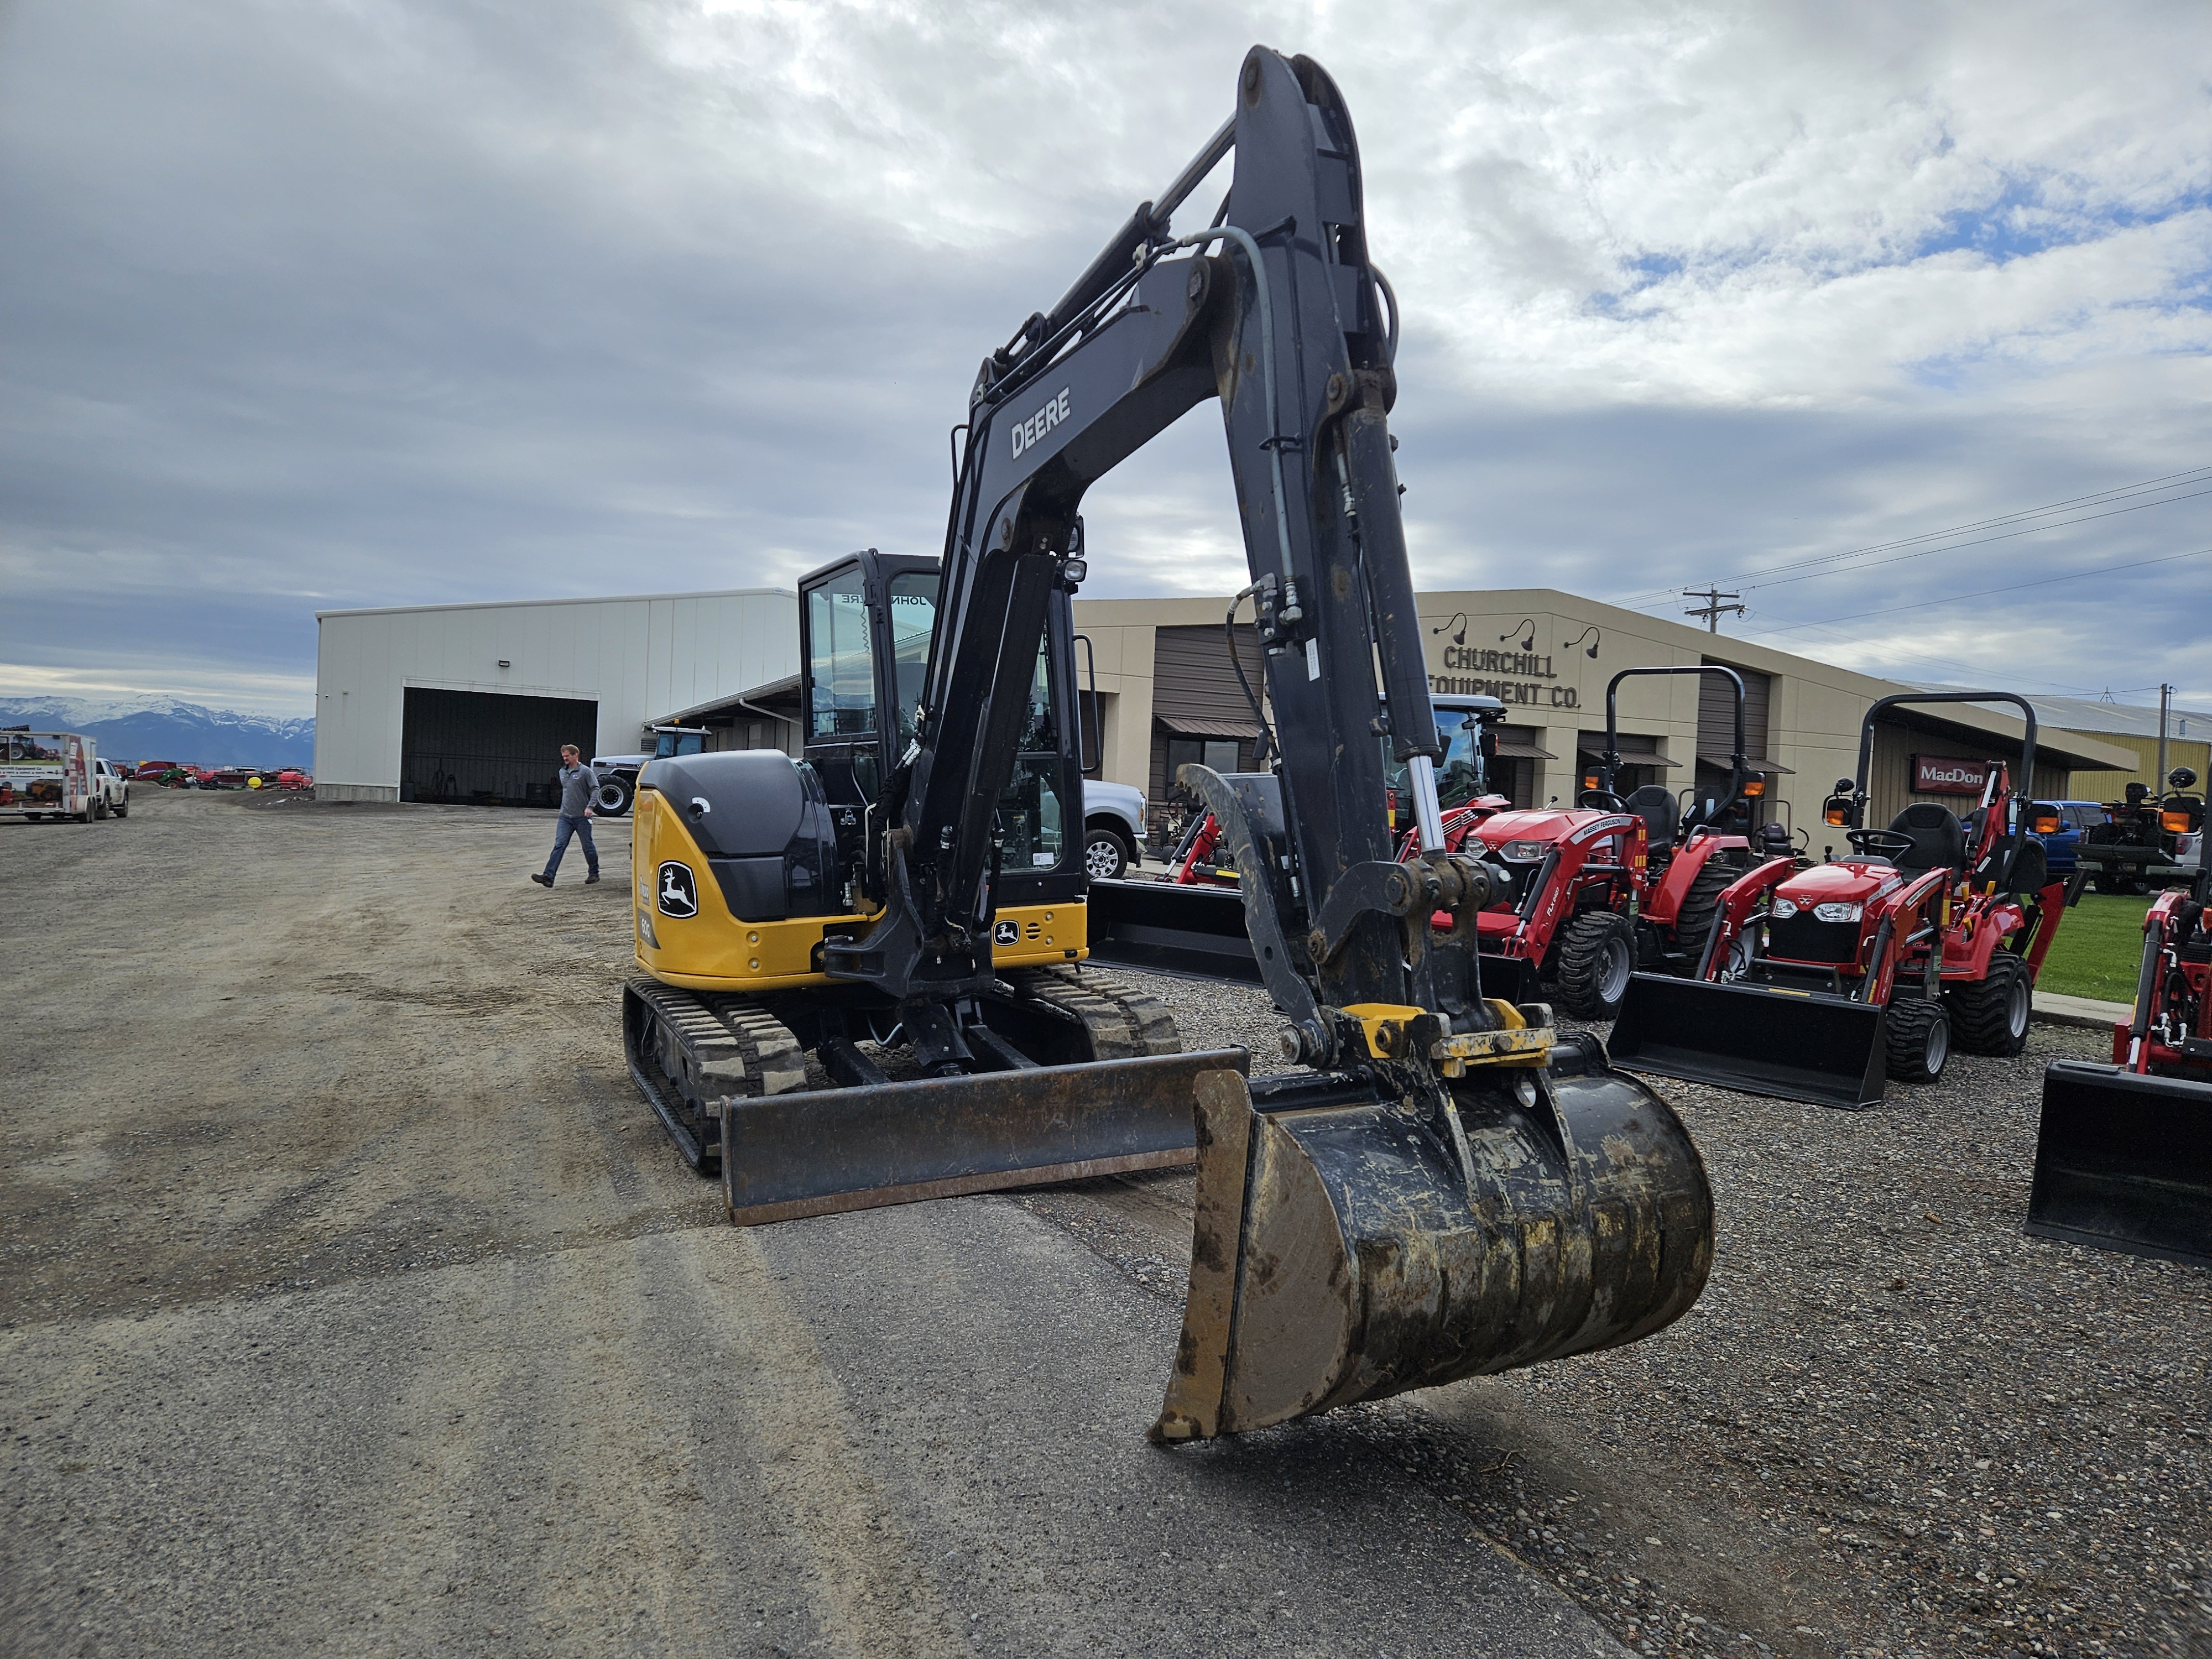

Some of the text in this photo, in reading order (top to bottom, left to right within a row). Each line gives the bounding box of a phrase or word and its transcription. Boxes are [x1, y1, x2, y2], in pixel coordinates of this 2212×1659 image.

[1011, 387, 1070, 460] DEERE
[1444, 646, 1557, 678] CHURCHILL
[1552, 686, 1582, 708] CO.
[1921, 766, 1983, 784] MacDon
[1583, 818, 1621, 836] MASSEY FERGUSON
